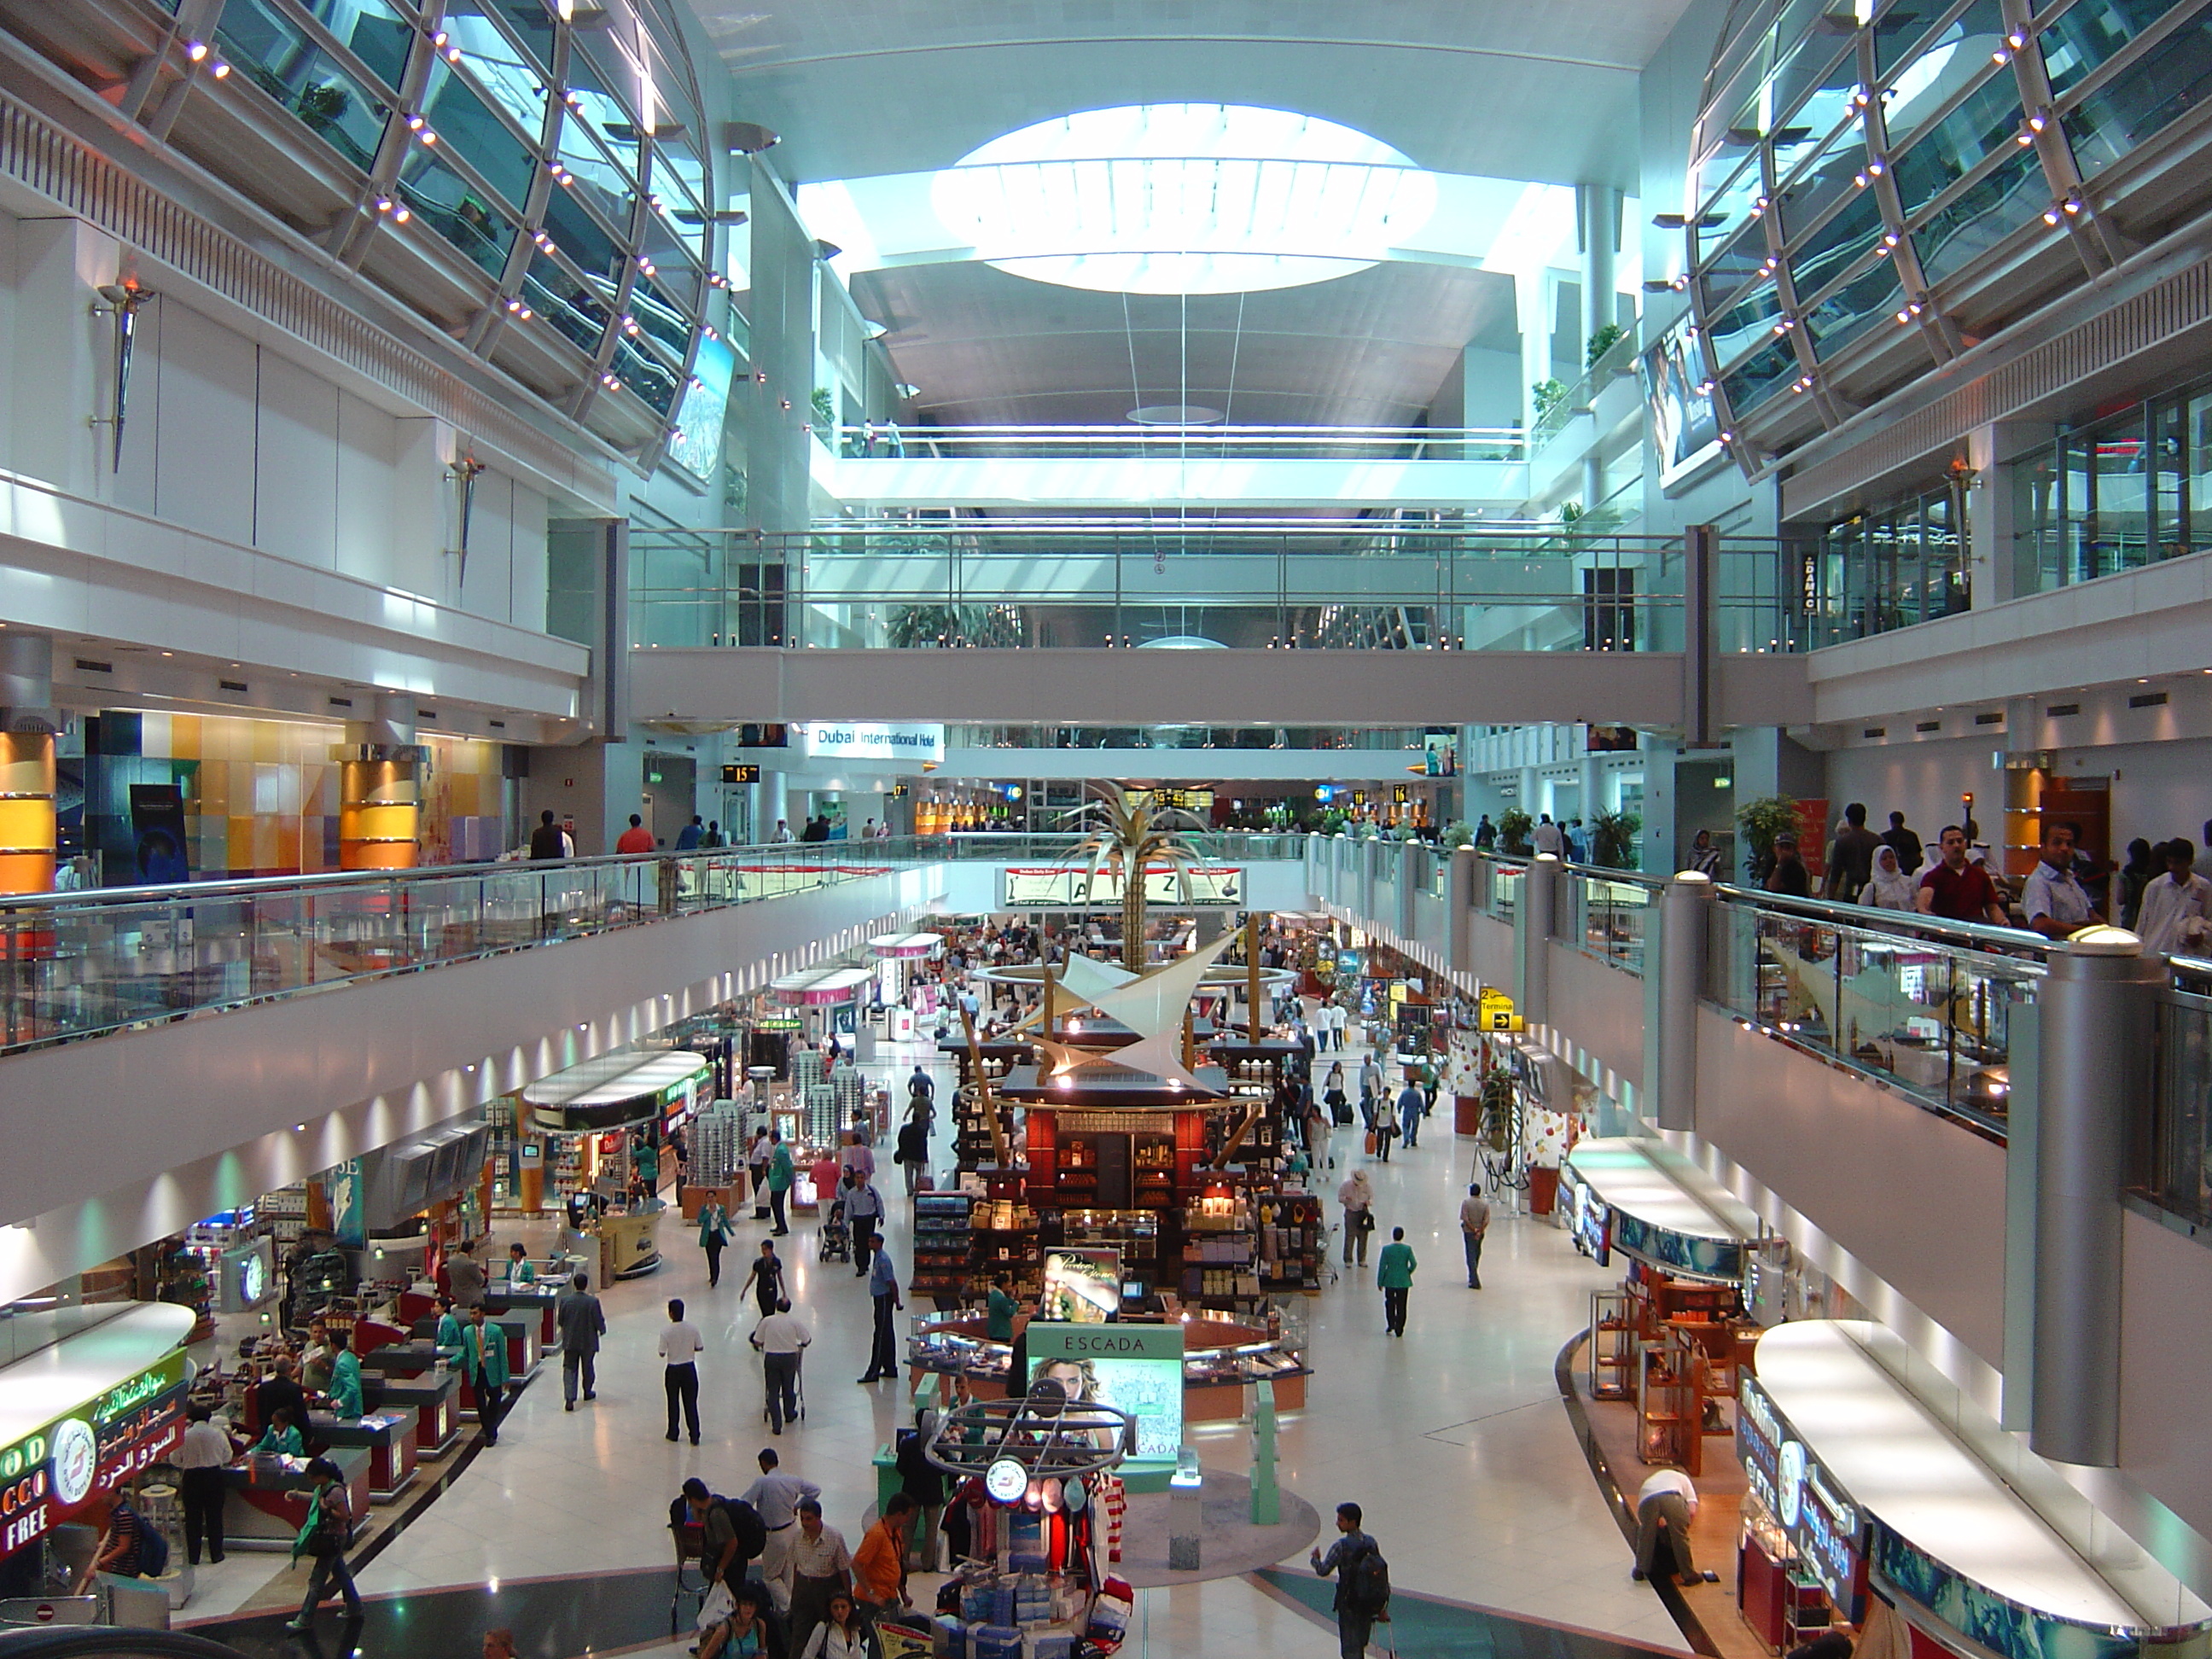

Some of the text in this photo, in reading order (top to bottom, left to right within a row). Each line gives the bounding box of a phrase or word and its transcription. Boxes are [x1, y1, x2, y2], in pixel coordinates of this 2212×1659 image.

[1805, 565, 1815, 608] DAMAC
[818, 730, 855, 743] Dubai
[860, 731, 917, 745] International
[736, 767, 748, 782] 15
[1162, 876, 1175, 892] Z
[1481, 990, 1488, 999] 2
[1065, 1336, 1145, 1351] ESCADA
[137, 1424, 176, 1470] السوق
[98, 1450, 135, 1490] الحرة
[1746, 1455, 1776, 1512] GIFTS
[6, 1504, 49, 1551] FREE
